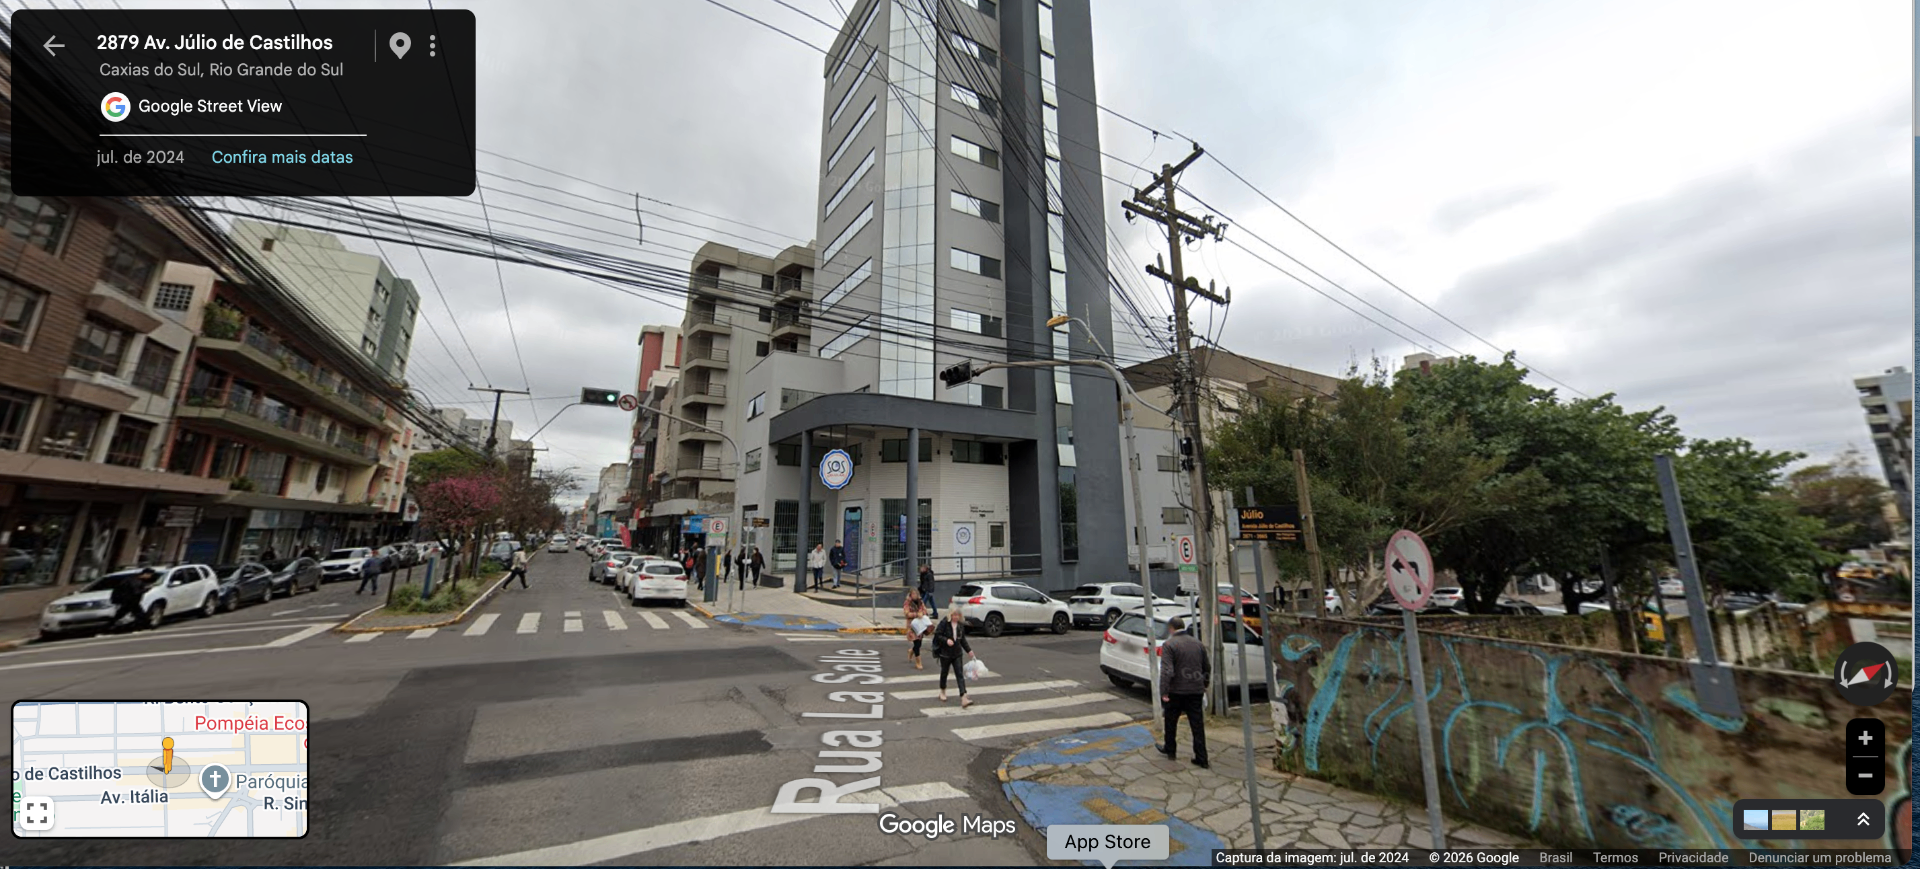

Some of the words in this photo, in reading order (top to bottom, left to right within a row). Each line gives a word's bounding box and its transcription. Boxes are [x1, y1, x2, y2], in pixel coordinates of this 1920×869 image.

[827, 460, 846, 475] SOS
[1241, 509, 1264, 520] Júlio
[1183, 542, 1190, 558] E
